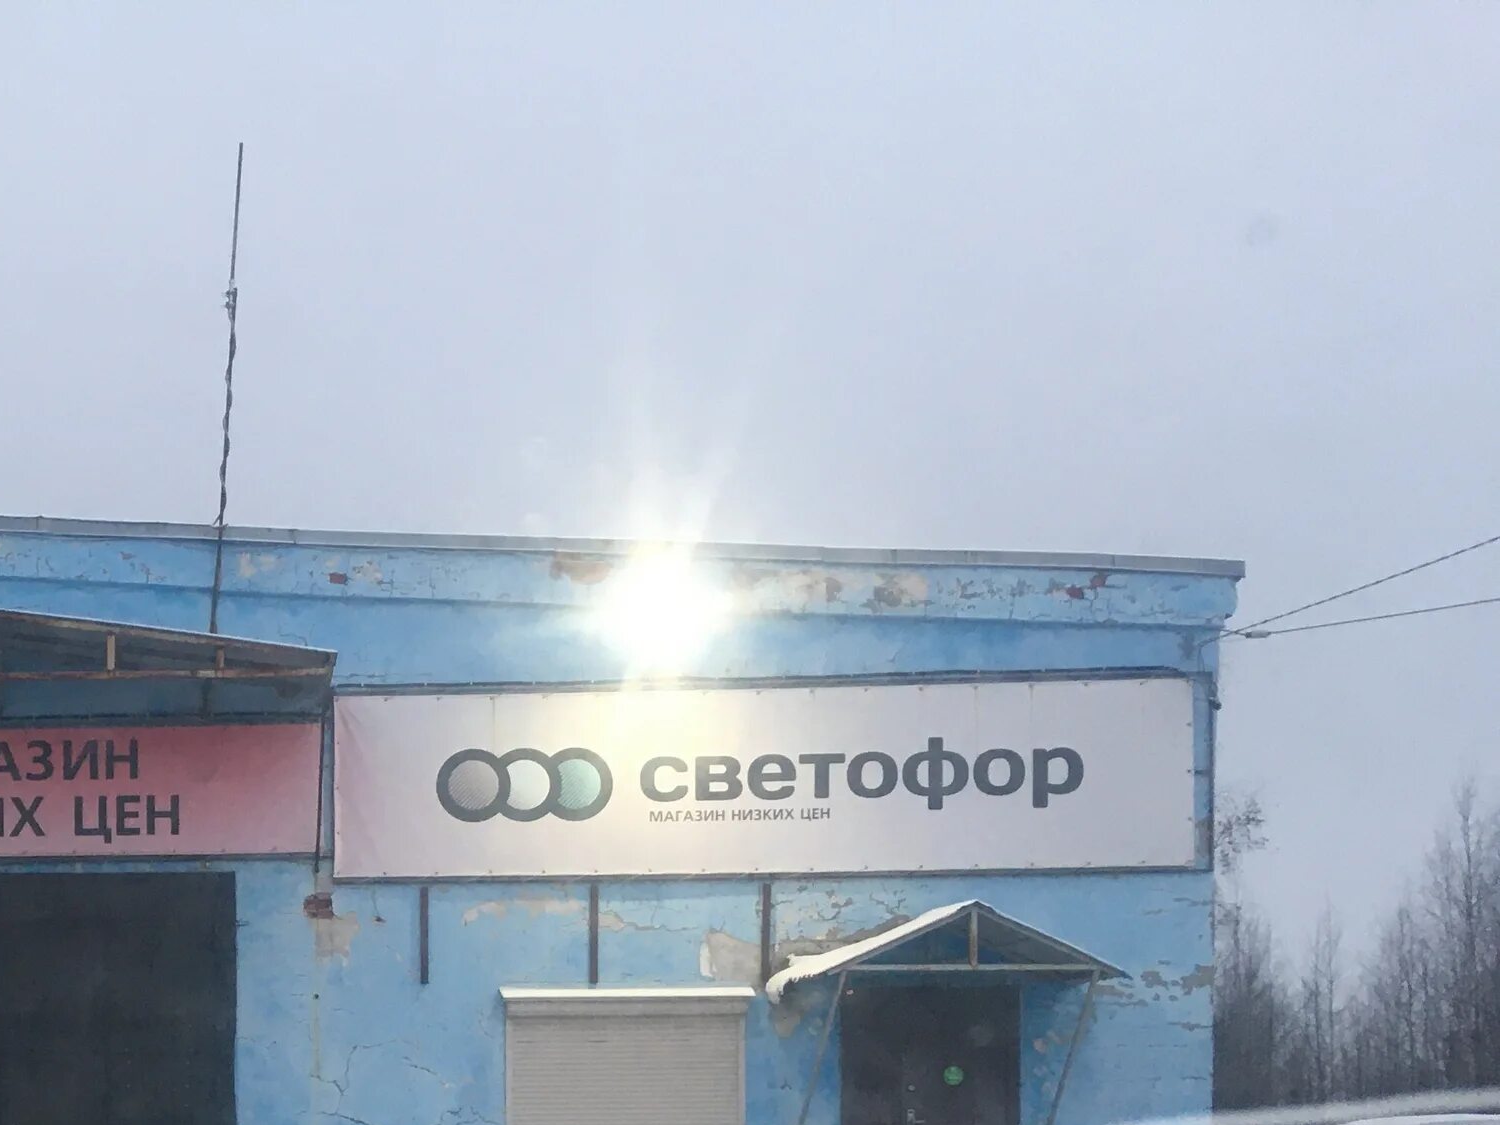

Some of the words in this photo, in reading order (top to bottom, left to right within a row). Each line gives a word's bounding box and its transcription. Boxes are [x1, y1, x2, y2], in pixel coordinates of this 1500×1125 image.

[640, 737, 1085, 810] светофор
[74, 794, 180, 843] ЦЕН
[649, 810, 726, 822] МАГАЗИН
[731, 809, 794, 821] НИЗКИХ
[800, 807, 831, 821] ЦЕН
